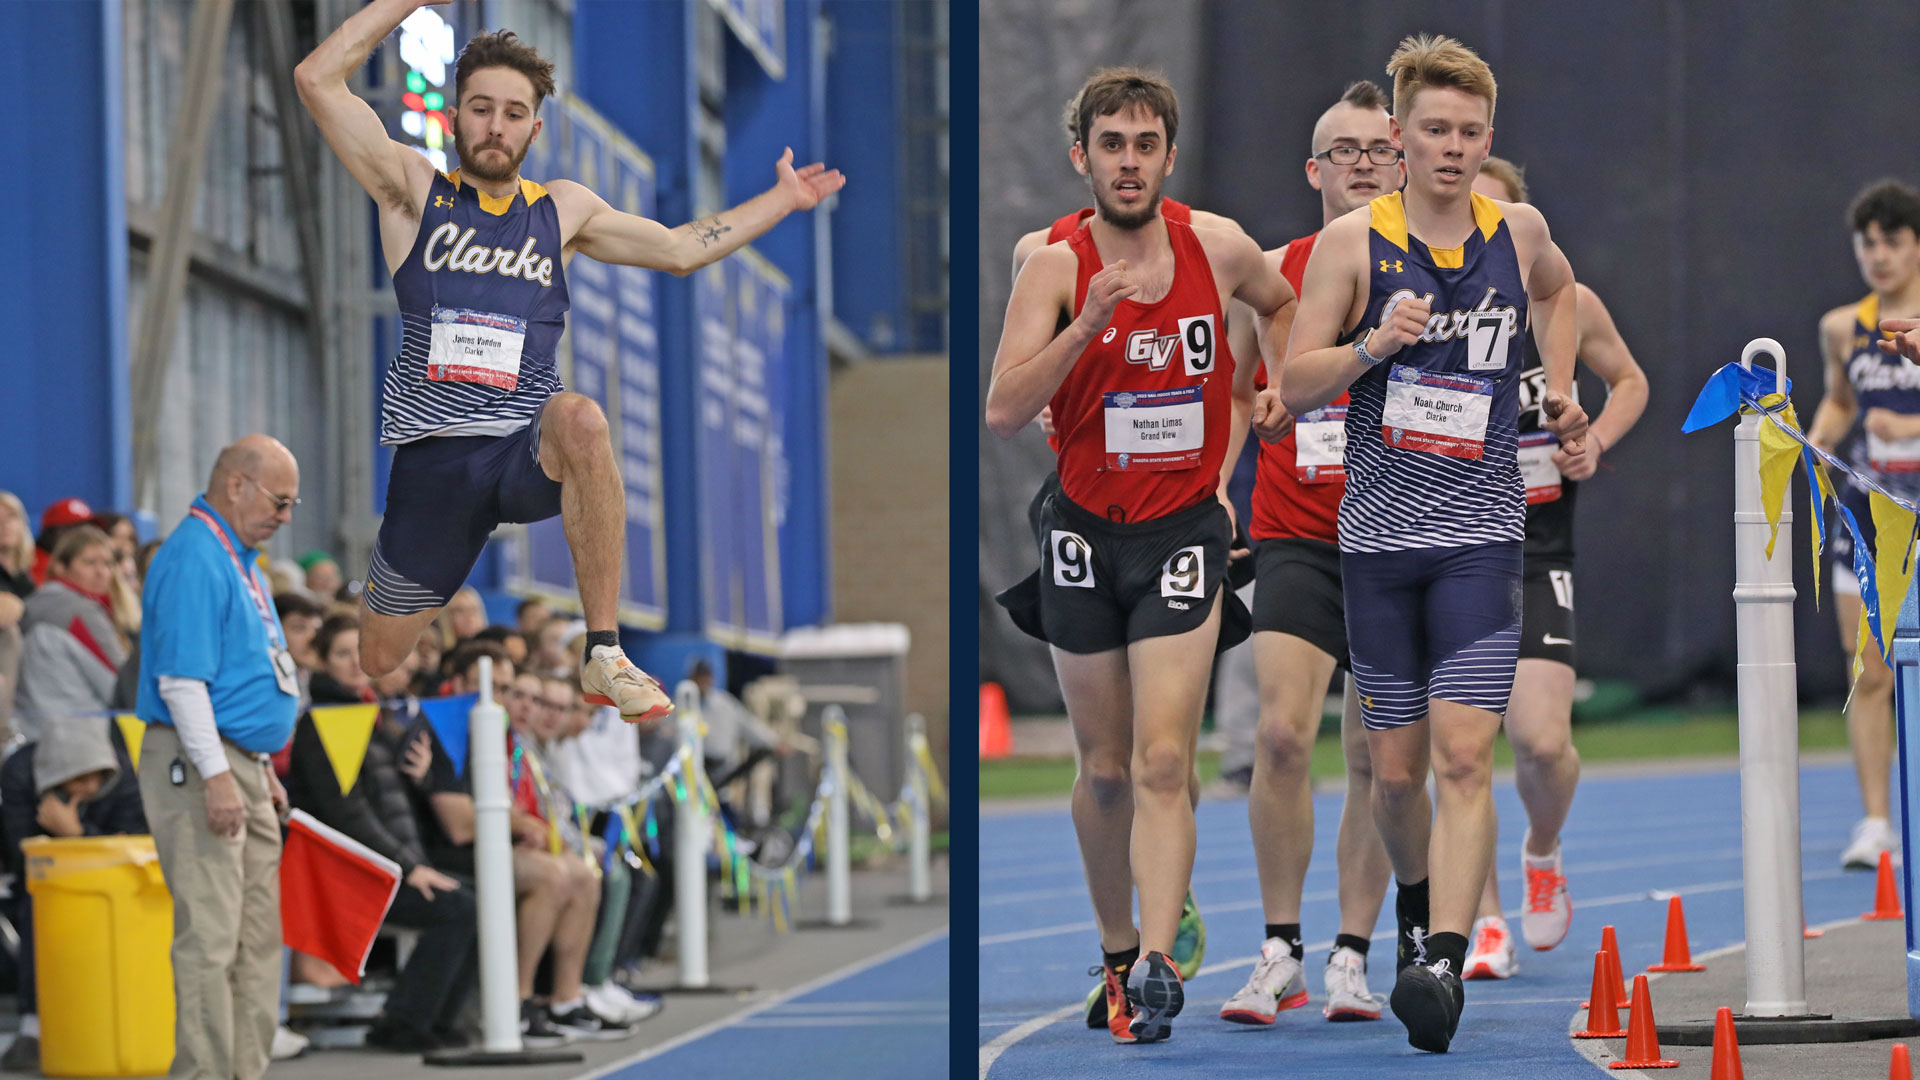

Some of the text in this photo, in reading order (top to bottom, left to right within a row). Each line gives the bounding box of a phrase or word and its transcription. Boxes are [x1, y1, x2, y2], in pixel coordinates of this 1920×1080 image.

[424, 221, 553, 287] Clarke
[465, 347, 483, 357] Clarke
[1125, 329, 1183, 372] GV
[1187, 320, 1212, 370] 9
[1476, 318, 1502, 362] 7
[1133, 417, 1183, 429] Nathan Limas
[1413, 396, 1462, 413] Noah Church
[1426, 411, 1447, 422] Clarke
[1140, 430, 1176, 440] Grand View
[1058, 535, 1087, 583] 9
[1169, 551, 1199, 592] 9
